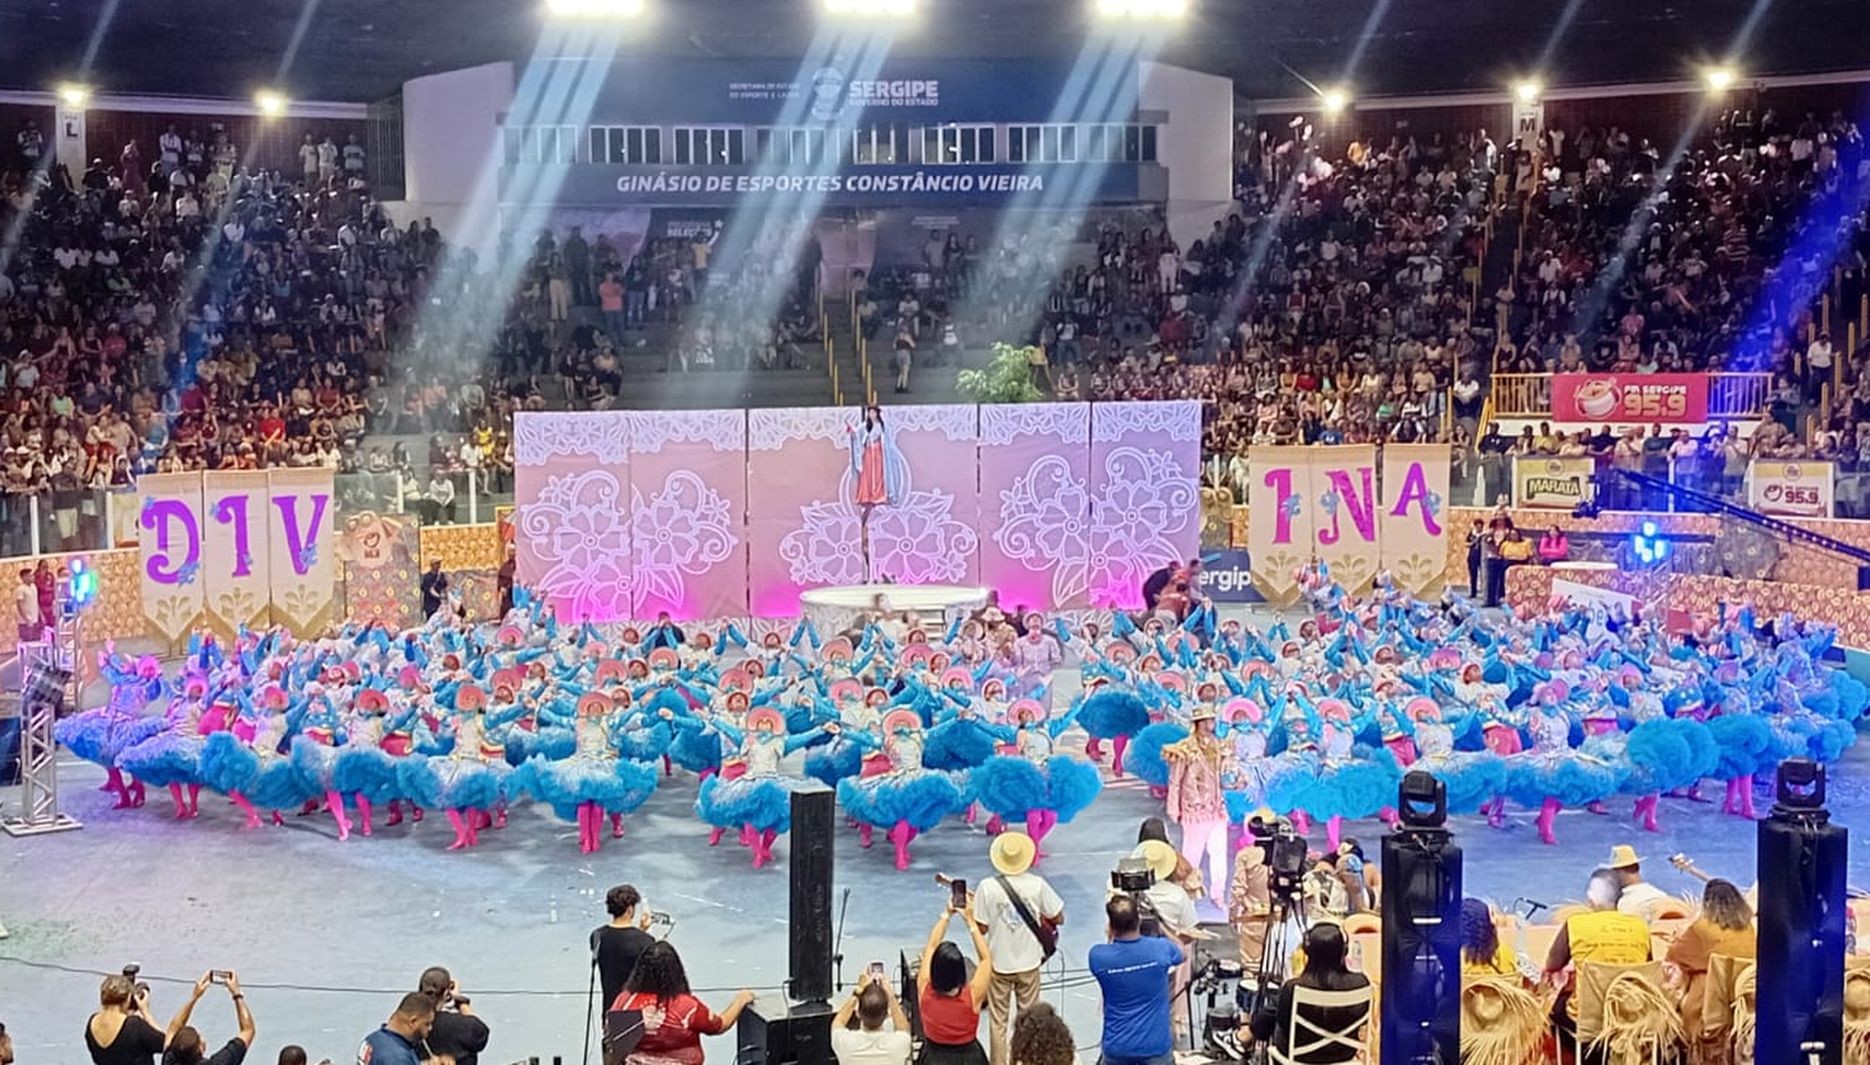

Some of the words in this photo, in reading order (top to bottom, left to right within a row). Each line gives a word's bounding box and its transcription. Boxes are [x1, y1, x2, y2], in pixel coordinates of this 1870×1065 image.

[849, 80, 939, 98] SERGIPE
[66, 122, 78, 137] L
[1520, 118, 1535, 132] M
[616, 171, 701, 192] GINÁSIO
[705, 175, 734, 192] DE
[735, 175, 842, 192] ESPORTES
[846, 171, 974, 192] CONSTÂNCIO
[977, 175, 1044, 192] VIEIRA
[1198, 566, 1252, 592] ergip
